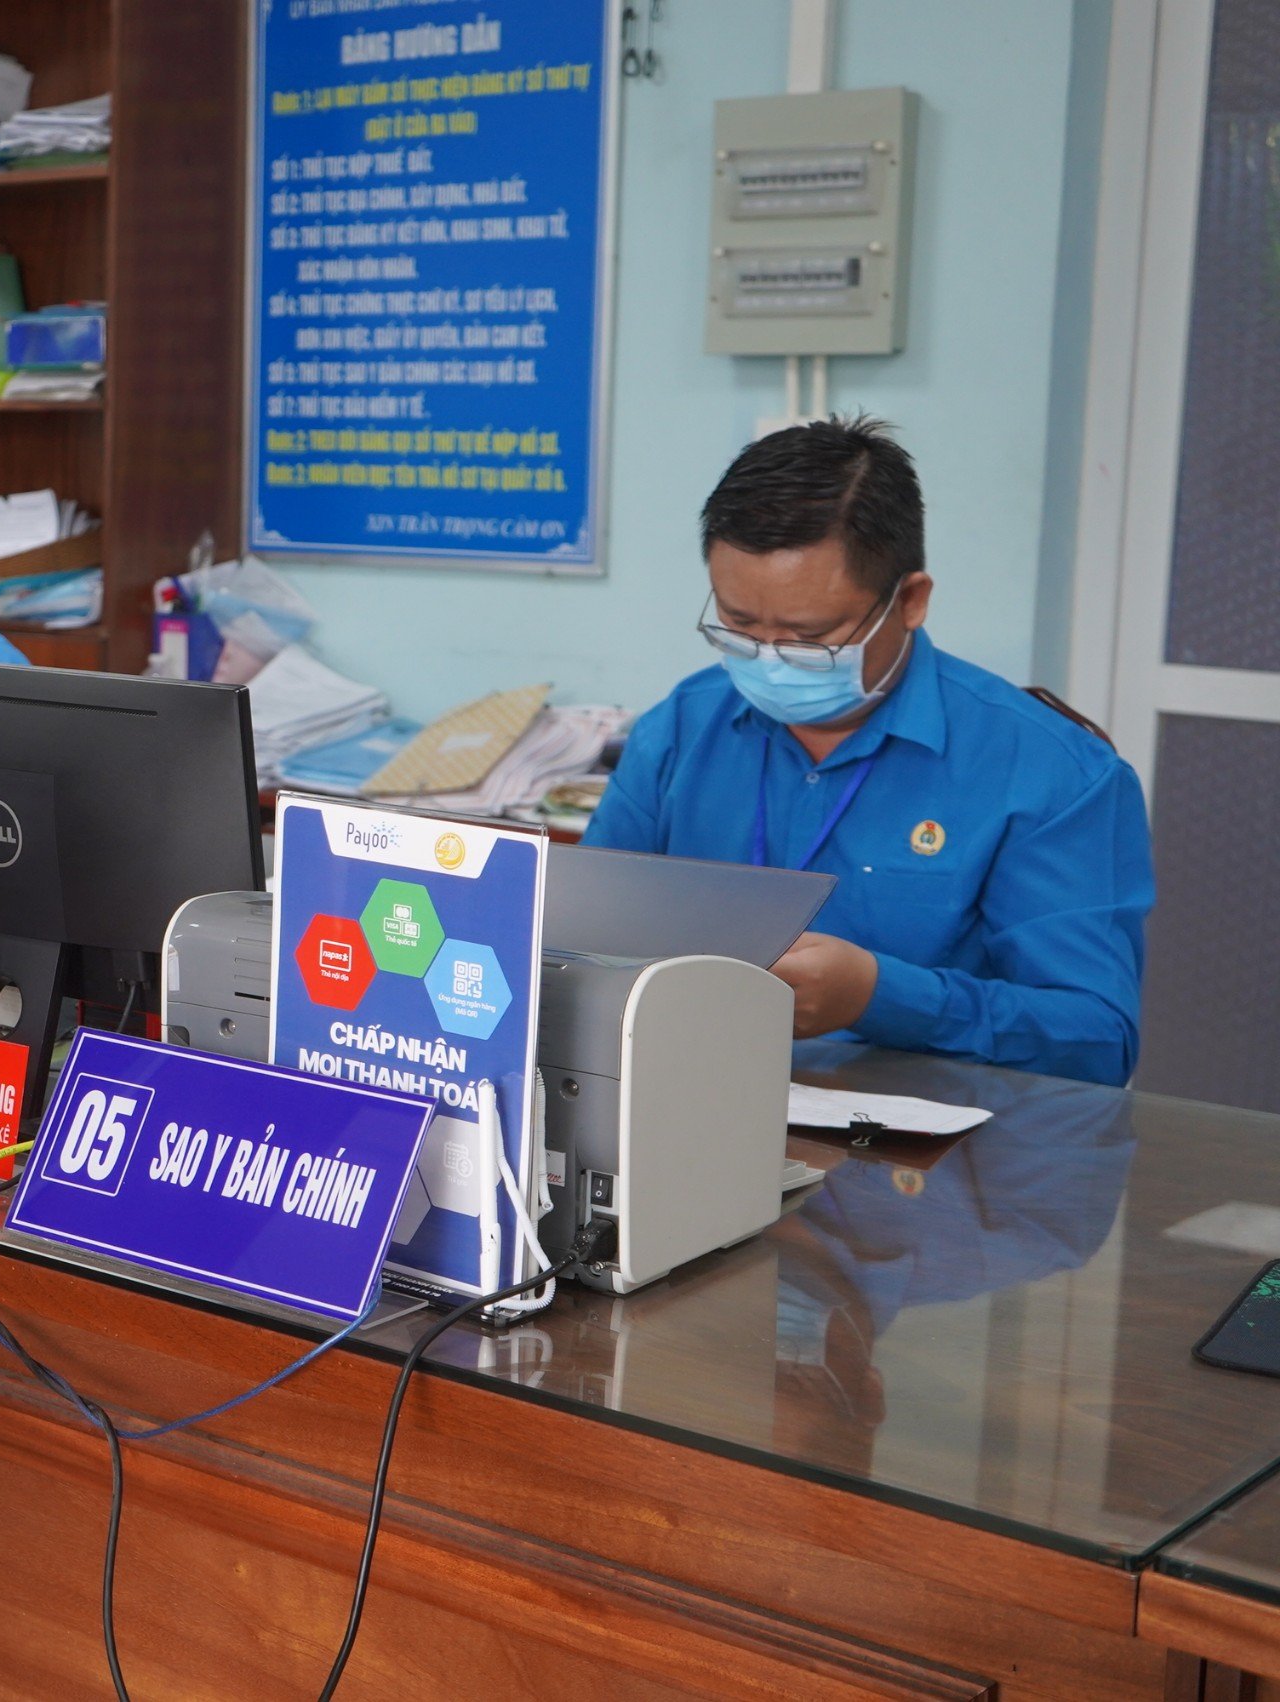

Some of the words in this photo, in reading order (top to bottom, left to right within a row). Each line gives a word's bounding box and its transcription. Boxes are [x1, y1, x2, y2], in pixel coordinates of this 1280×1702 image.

[346, 822, 388, 853] Payoo
[330, 1021, 396, 1055] CHẤP
[397, 1035, 467, 1074] NHẬN
[344, 1058, 426, 1097] THANH
[428, 1078, 480, 1113] TOÁ
[59, 1089, 138, 1181] 05
[149, 1122, 208, 1188] SAO
[203, 1133, 233, 1192] Y
[221, 1123, 290, 1208] BẢN
[282, 1147, 376, 1228] CHÍNH
